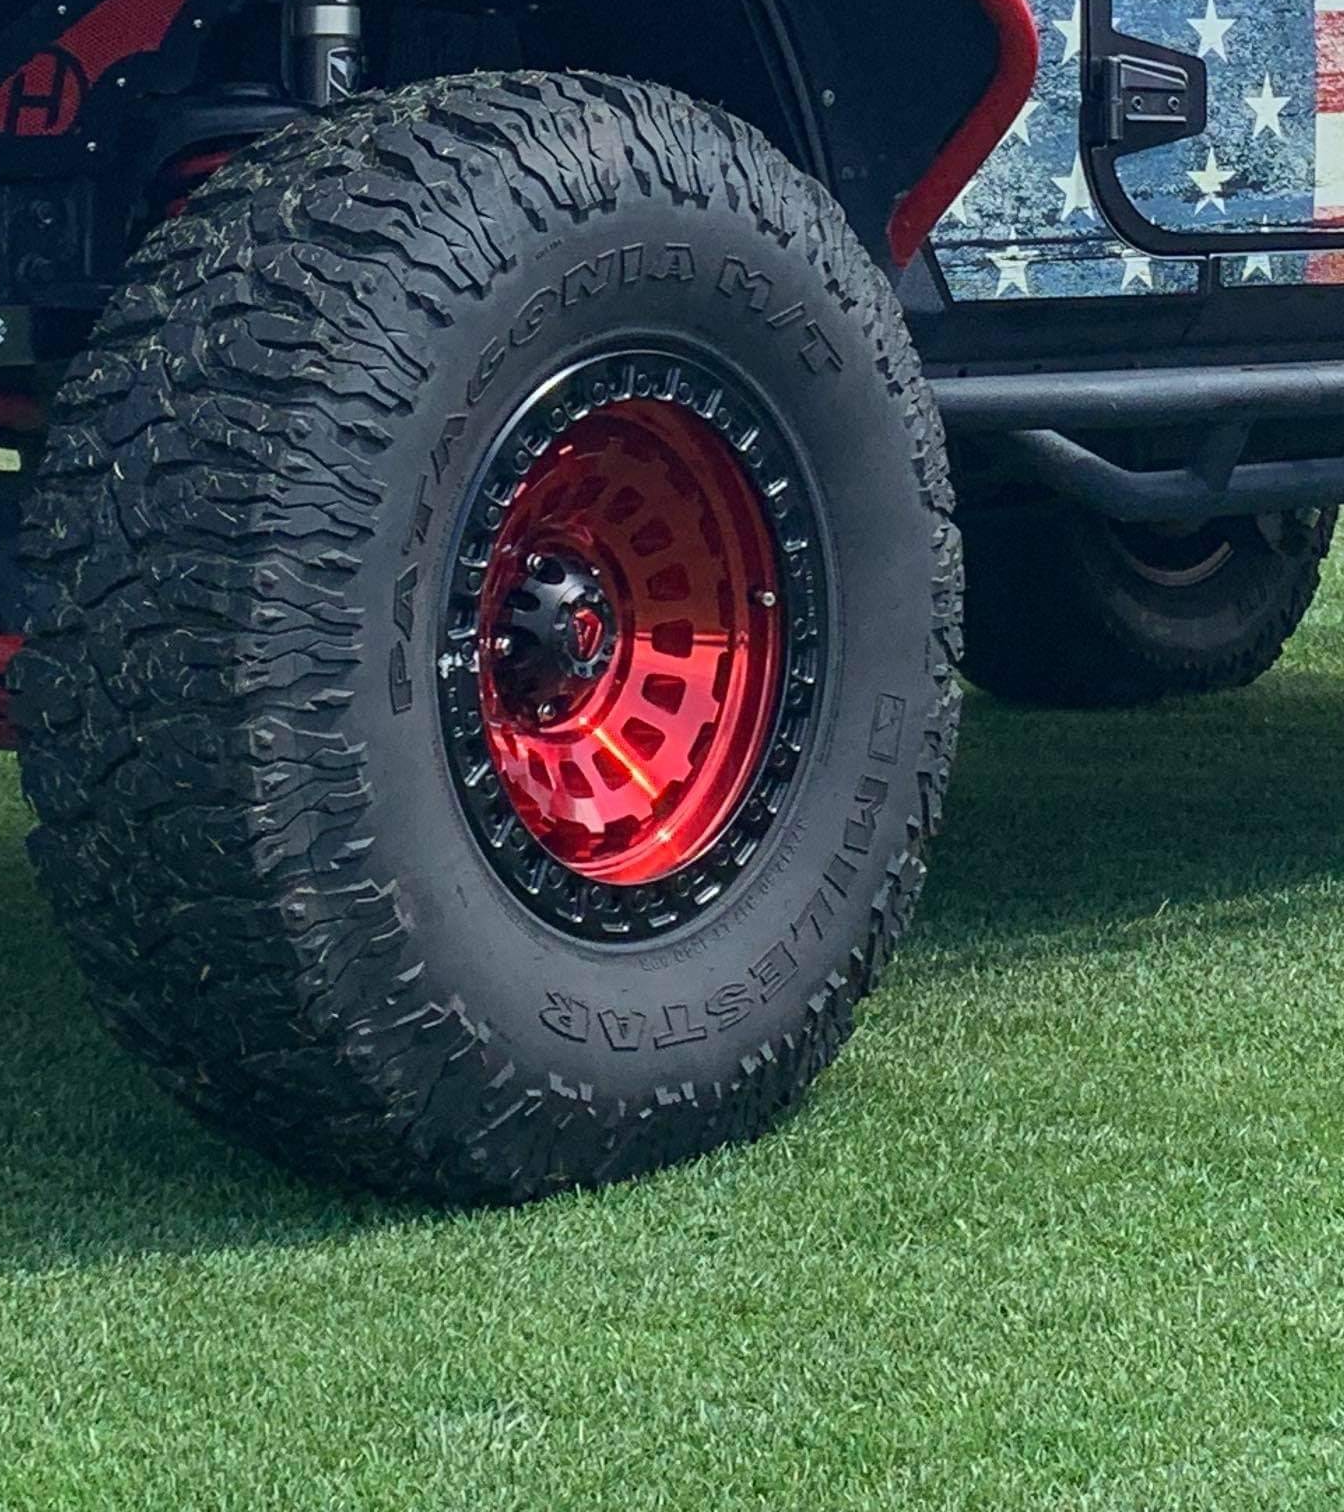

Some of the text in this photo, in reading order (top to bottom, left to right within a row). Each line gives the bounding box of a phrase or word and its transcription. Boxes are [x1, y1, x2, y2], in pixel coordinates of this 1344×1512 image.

[388, 242, 844, 717] PATAGONIA M/T
[539, 774, 889, 1051] MILESTAR
